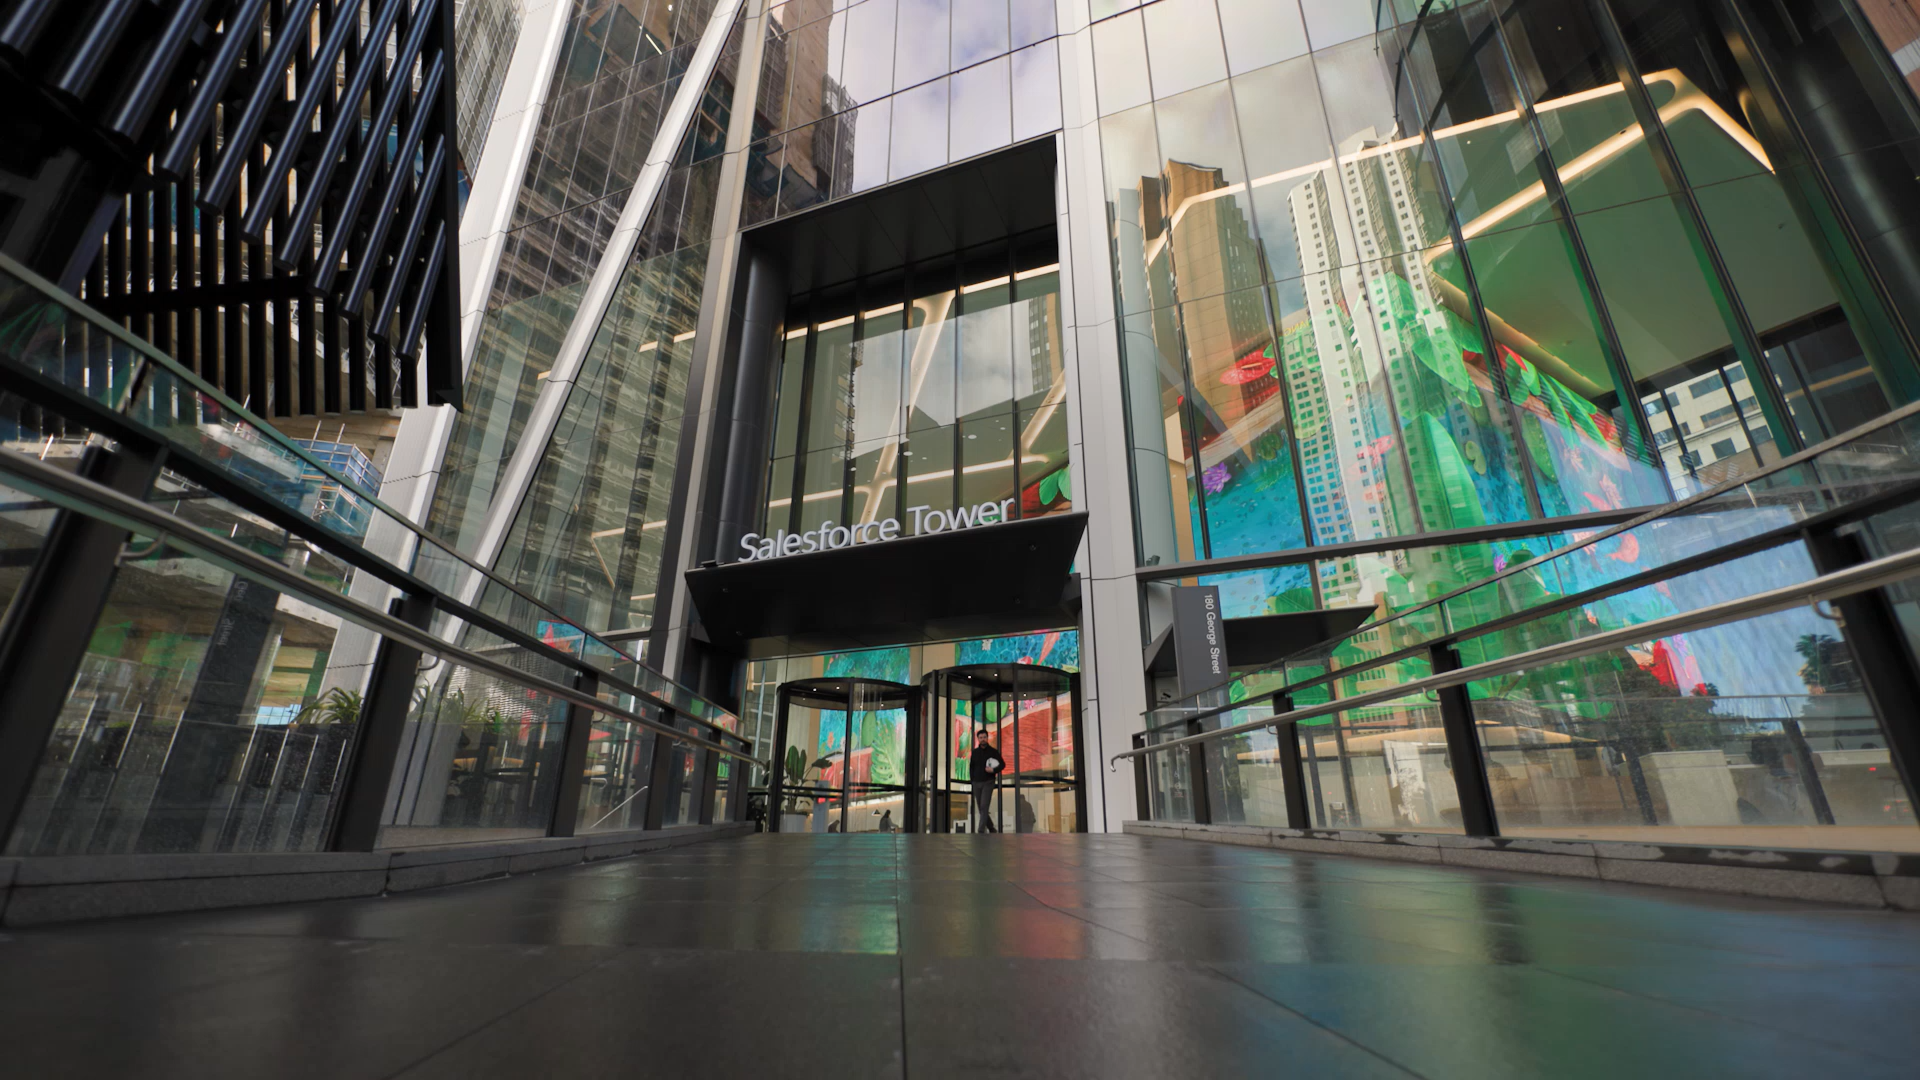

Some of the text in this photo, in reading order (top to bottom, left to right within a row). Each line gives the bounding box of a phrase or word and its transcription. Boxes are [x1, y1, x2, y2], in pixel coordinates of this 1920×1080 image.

[738, 498, 1015, 563] Salesforce Tower
[1204, 594, 1221, 674] 180 George Street
